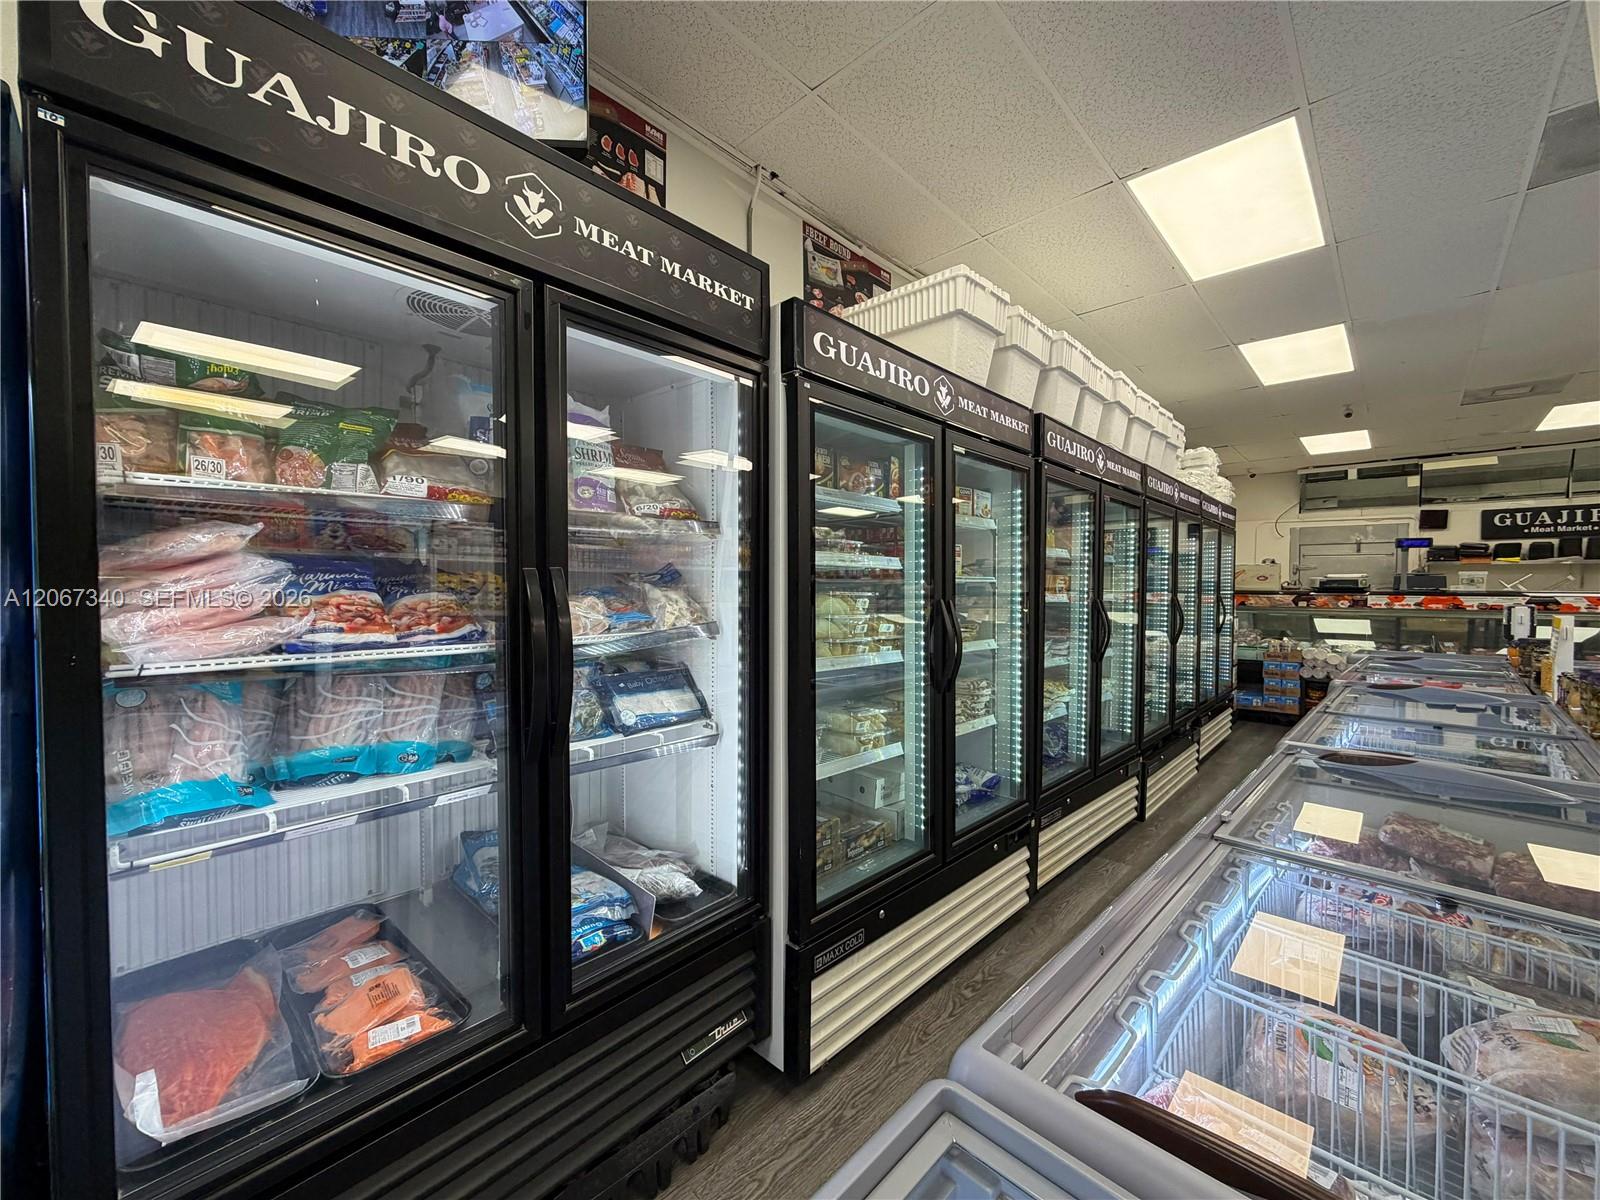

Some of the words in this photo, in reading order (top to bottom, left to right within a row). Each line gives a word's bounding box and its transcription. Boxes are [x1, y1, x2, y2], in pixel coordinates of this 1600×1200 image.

[77, 0, 490, 195] GUAJIRO
[573, 216, 654, 266] MEAT
[660, 255, 755, 311] MARKET
[829, 238, 852, 260] ROUND
[813, 331, 930, 397] GUAJIRO
[958, 396, 989, 418] MEAT
[990, 410, 1030, 434] MARKET
[1047, 431, 1095, 463] GUAJIRO
[194, 459, 222, 474] 26/30
[822, 944, 845, 965] MAXX
[845, 933, 863, 951] COLD
